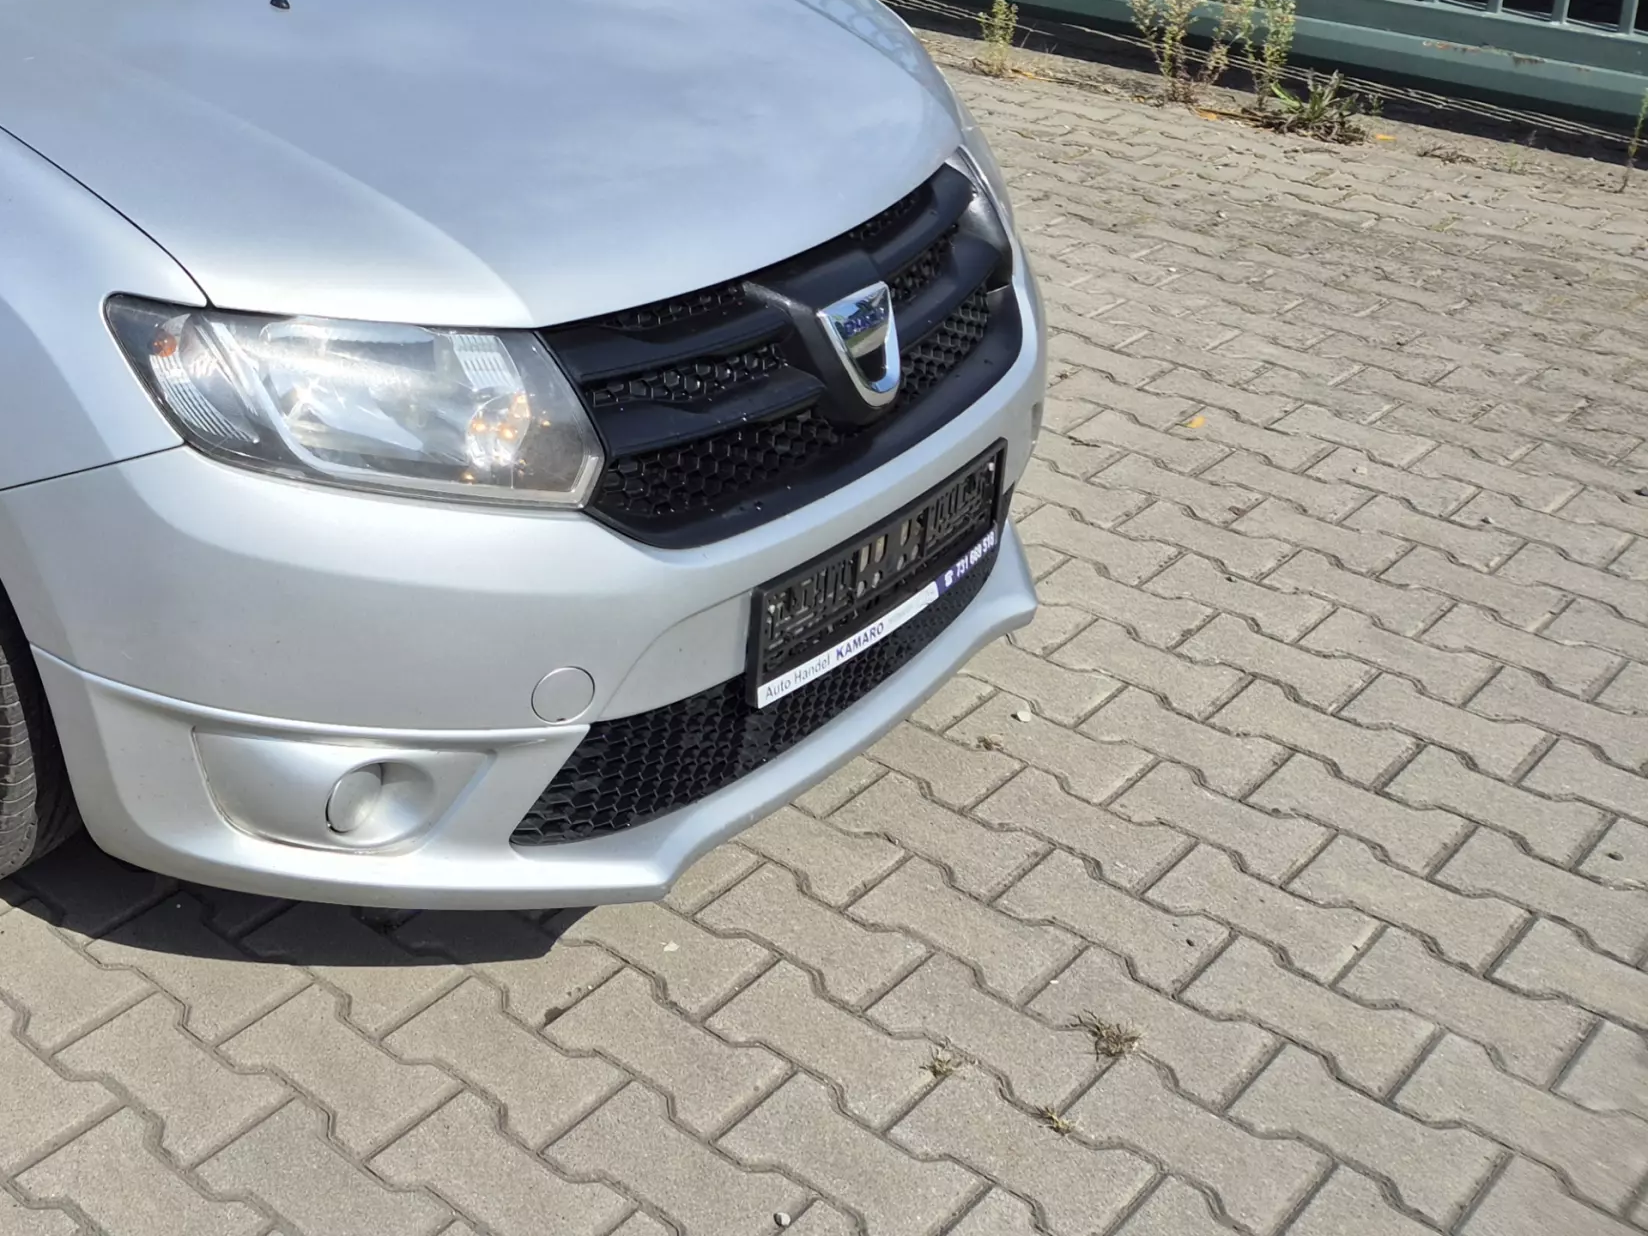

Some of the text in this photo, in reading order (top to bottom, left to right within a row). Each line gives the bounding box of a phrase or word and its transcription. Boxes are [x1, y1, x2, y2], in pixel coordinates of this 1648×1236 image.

[765, 622, 885, 701] Auto Handel KAMARO
